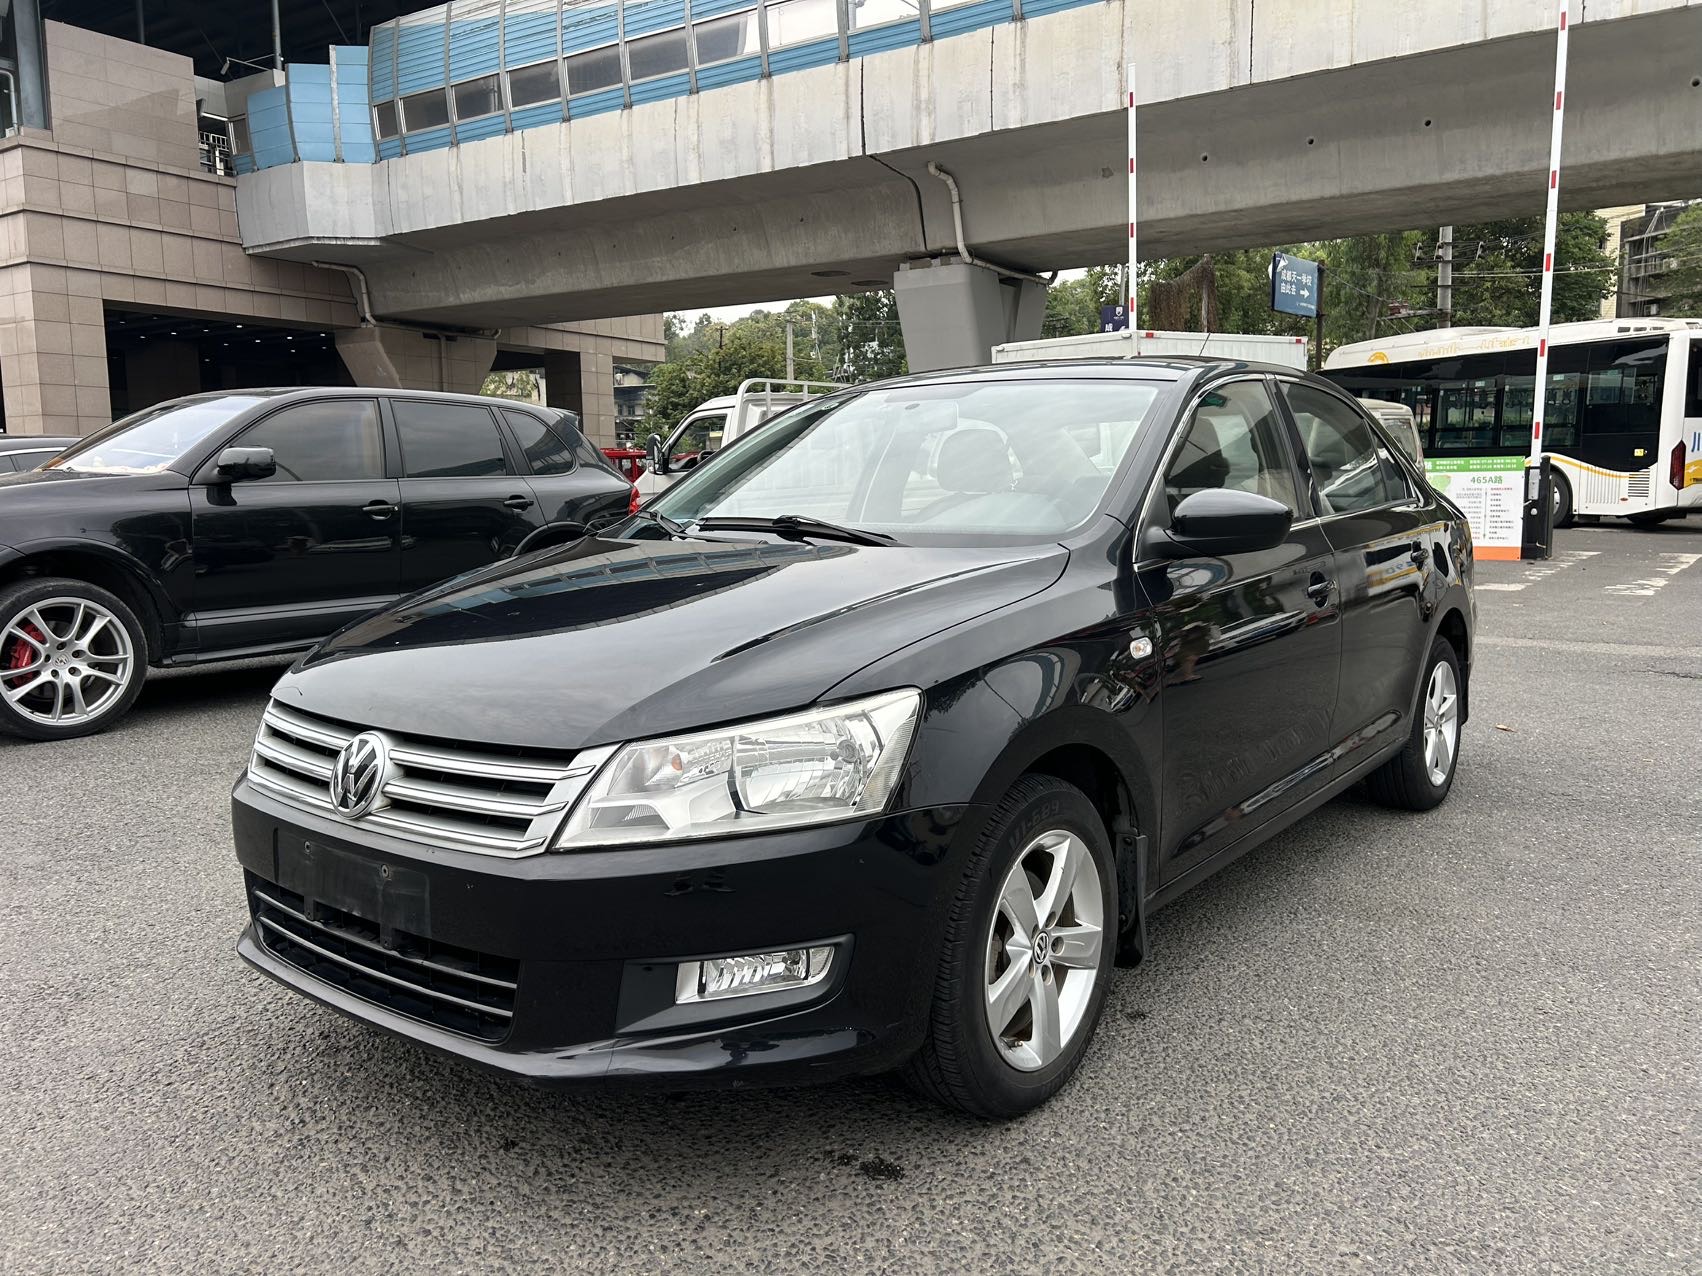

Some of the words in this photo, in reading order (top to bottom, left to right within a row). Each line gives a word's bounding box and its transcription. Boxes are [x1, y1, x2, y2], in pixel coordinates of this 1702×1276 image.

[1281, 268, 1312, 286] 成都天一学校
[1280, 282, 1297, 295] 由此去
[1470, 475, 1503, 485] 465A路
